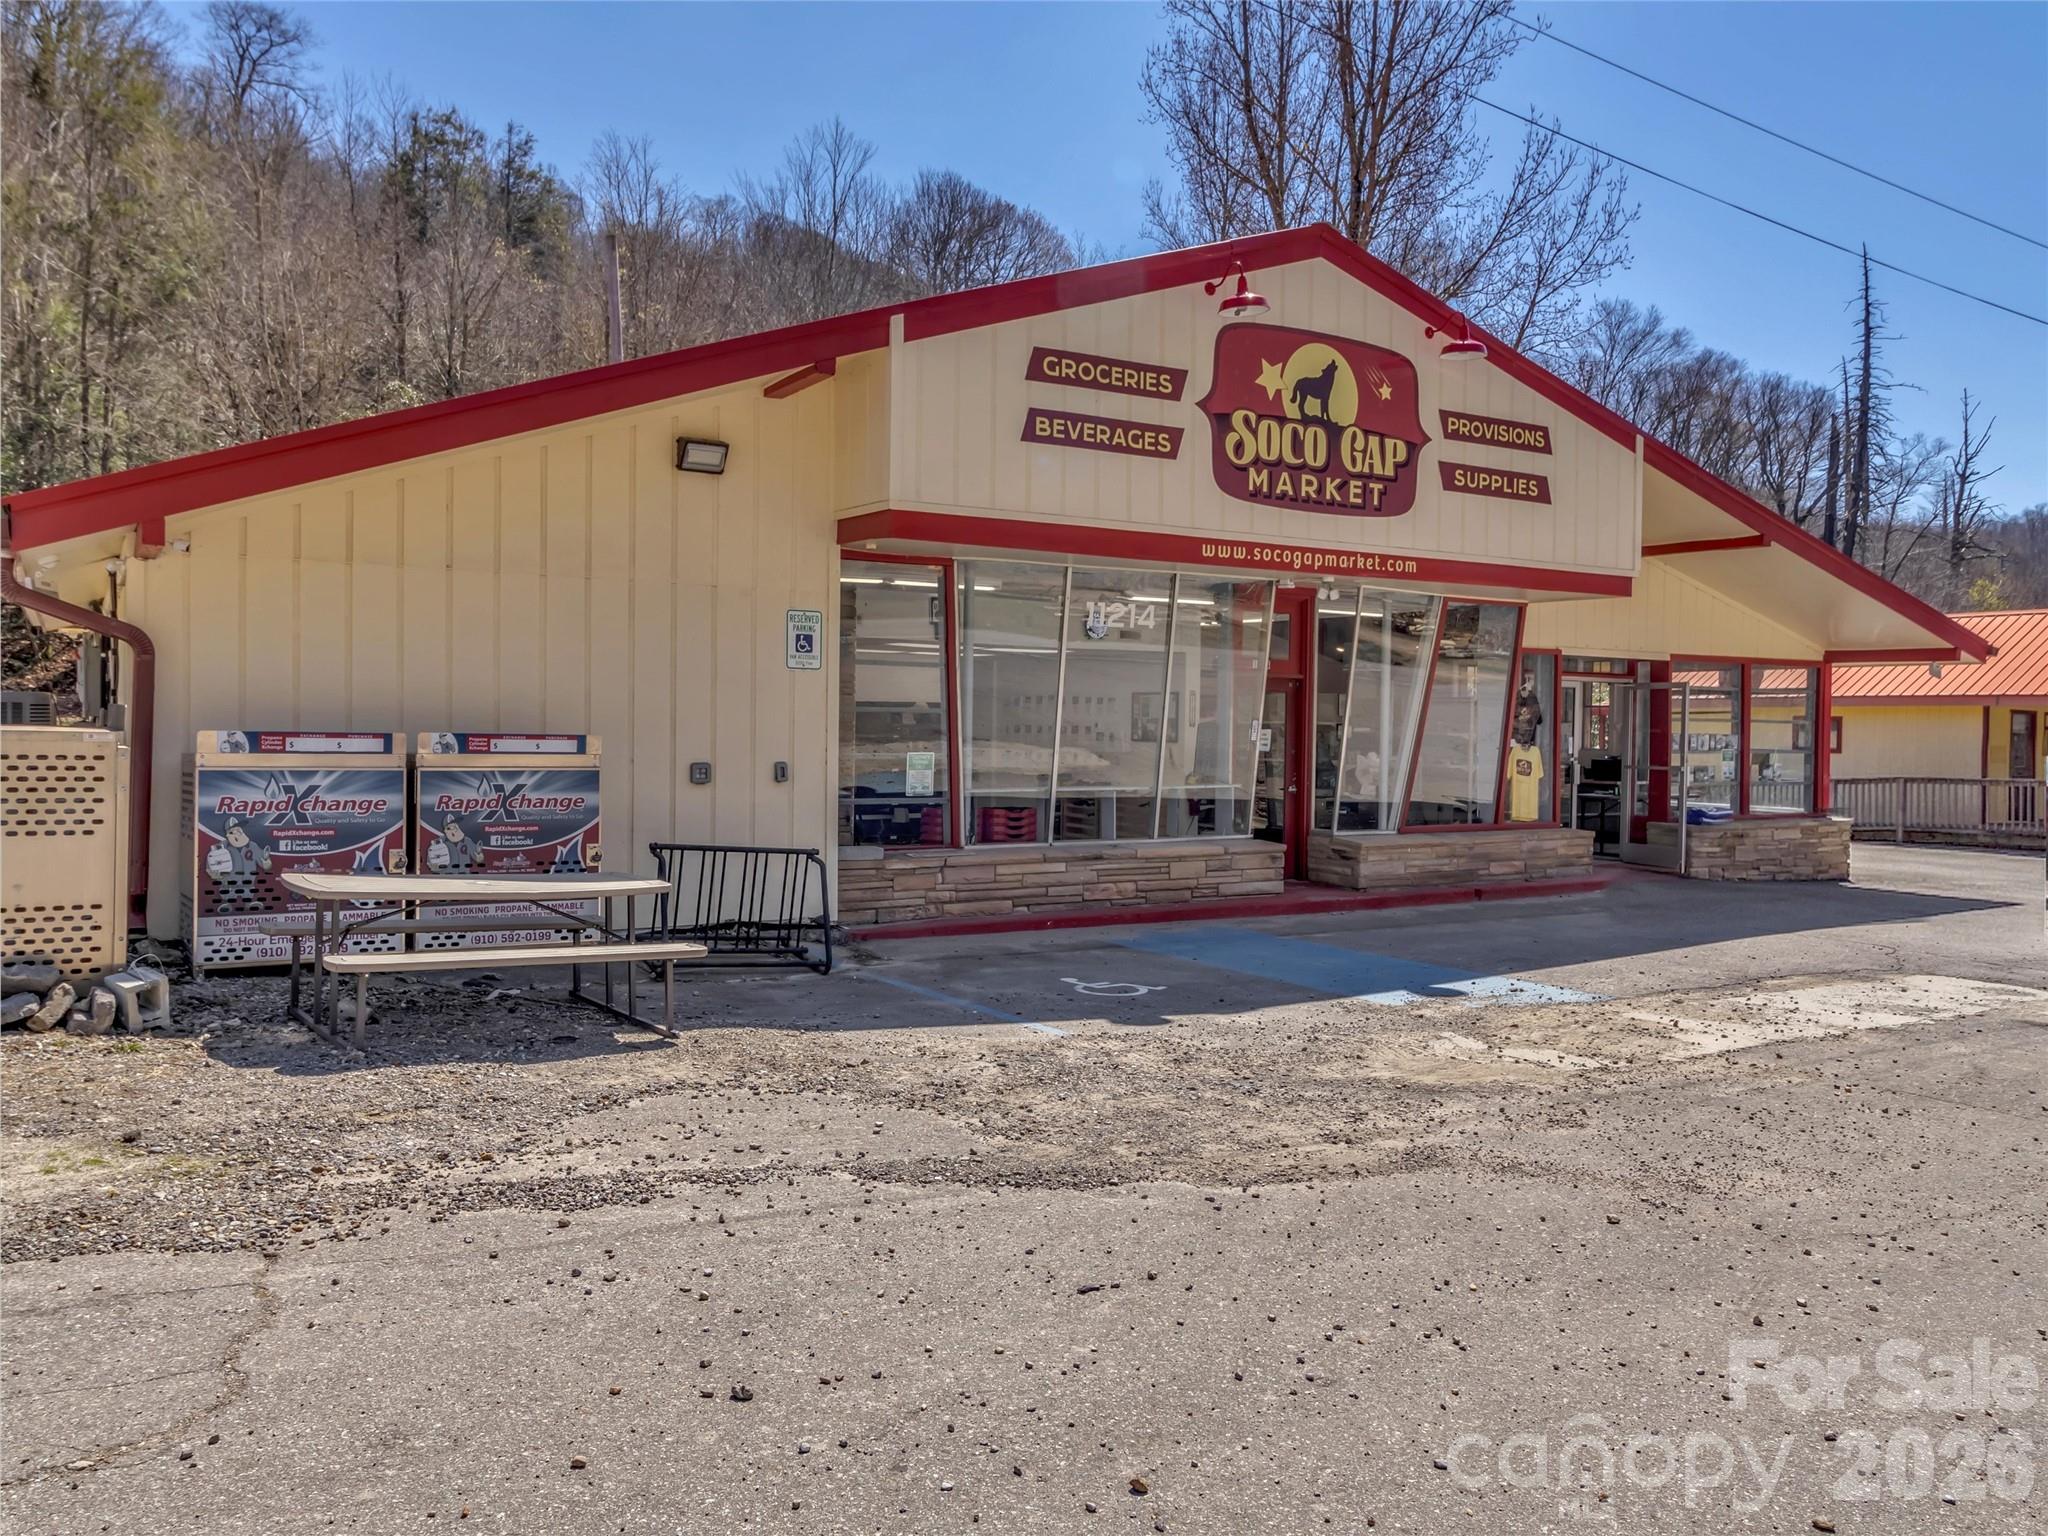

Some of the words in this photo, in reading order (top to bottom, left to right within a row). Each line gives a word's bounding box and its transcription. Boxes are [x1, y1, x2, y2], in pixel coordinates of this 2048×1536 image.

[1042, 356, 1173, 393] GROCERIES
[1035, 417, 1172, 453] BEVERAGES
[1447, 417, 1545, 448] PROVISIONS
[1225, 410, 1327, 468] SOCO
[1341, 427, 1407, 476] GAP
[1248, 468, 1383, 506] MARKET
[1454, 469, 1539, 496] SUPPLIES
[1202, 543, 1417, 573] www.socogapmarket.com
[790, 614, 819, 624] RESERVED
[1086, 602, 1155, 629] 11214
[793, 624, 816, 632] PARKING
[289, 738, 294, 748] $
[272, 829, 335, 837] RapidXchange.com
[293, 843, 328, 851] facebook!
[502, 838, 533, 846] facebook!
[244, 849, 253, 861] Q
[450, 907, 489, 915] SMOKING
[215, 919, 230, 927] NO
[232, 917, 278, 927] SMOKING
[285, 913, 327, 922] PROPAE
[218, 936, 266, 947] 24-Hour
[471, 935, 498, 945] (910)
[501, 932, 551, 942] 592-0199
[257, 947, 287, 958] (910)
